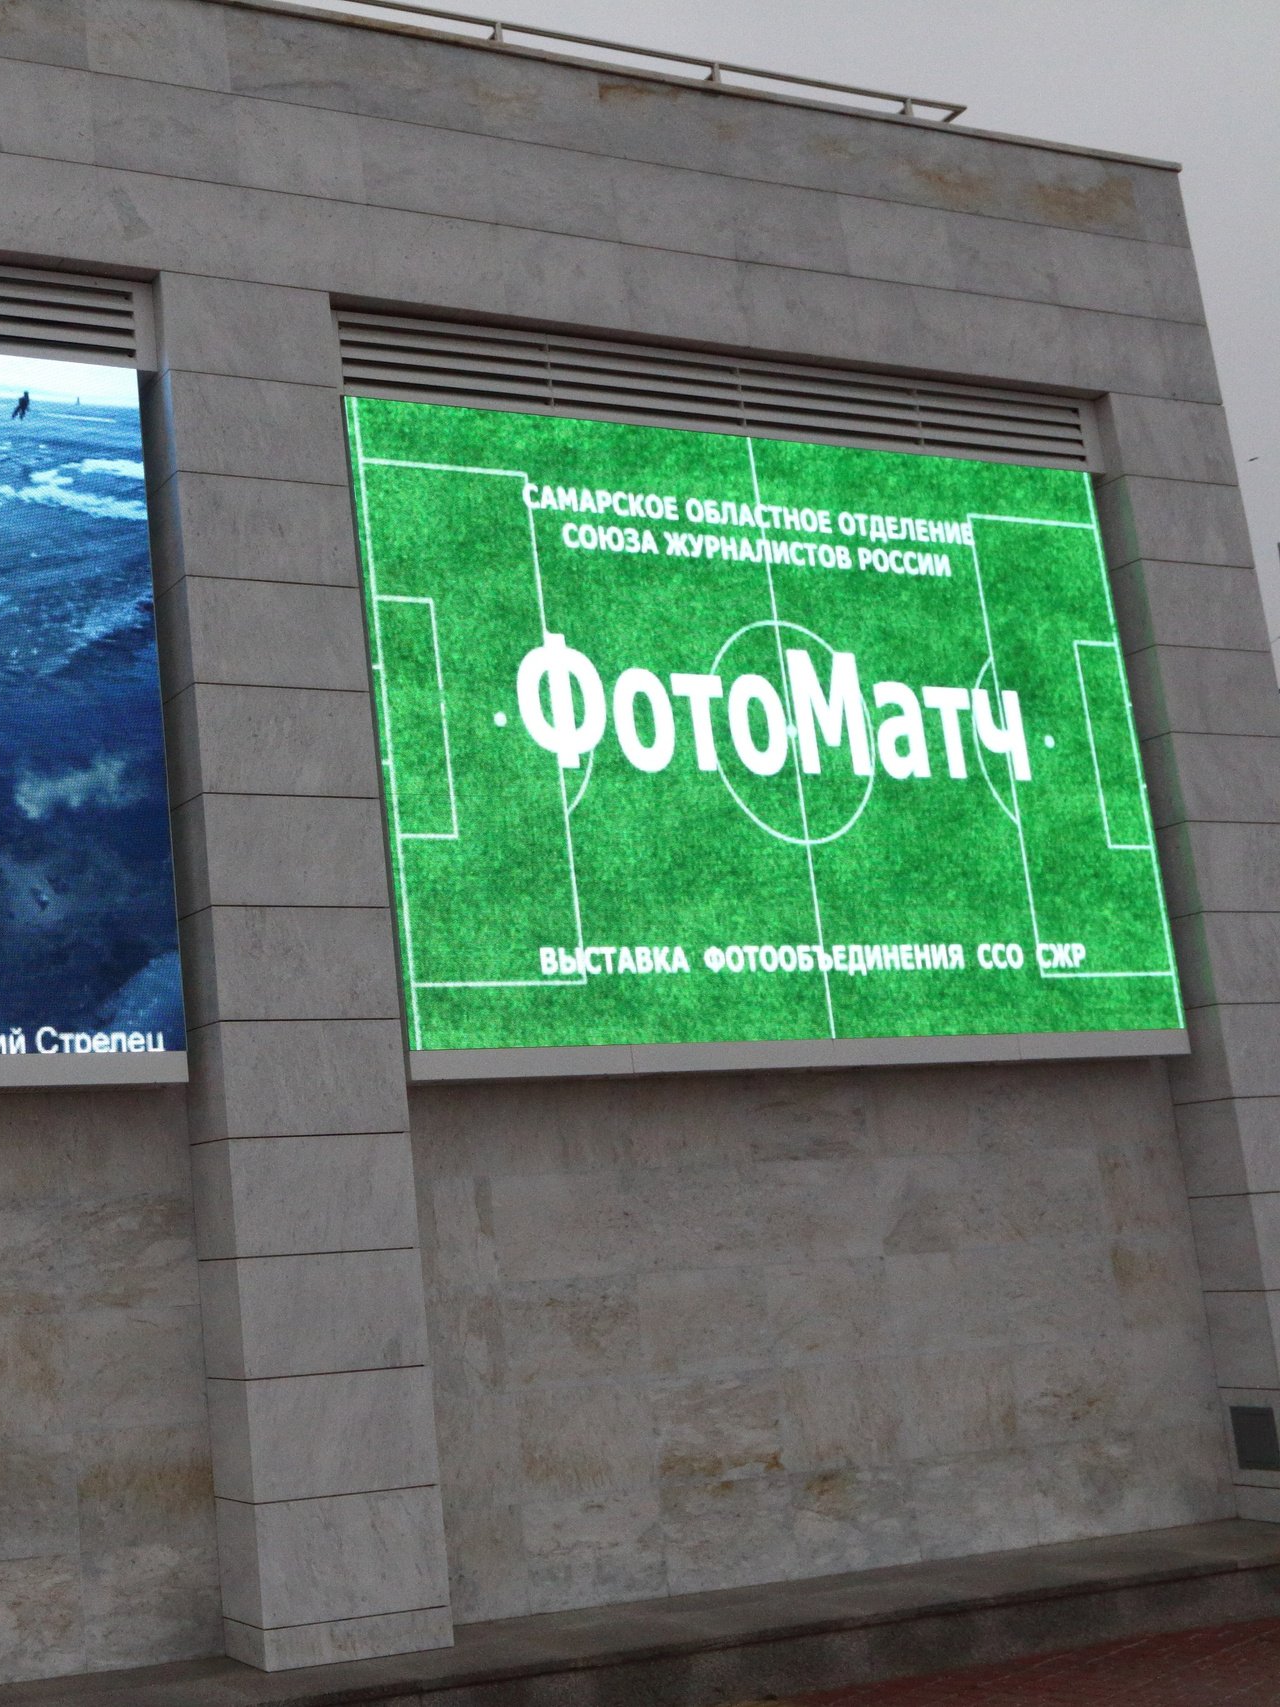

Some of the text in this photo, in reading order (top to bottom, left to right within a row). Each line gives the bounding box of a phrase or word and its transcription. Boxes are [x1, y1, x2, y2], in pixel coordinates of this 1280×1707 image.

[522, 483, 975, 546] САМАРСКОЕ ОБЛАСТНОЕ ОТДЕЛЕНИЕ
[562, 523, 952, 578] СОЮЗА ЖУРНАЛИСТОВ РОССИИ
[516, 633, 1032, 781] ФотоМатч
[540, 942, 1087, 976] ВЫСТАВКА ФОТООБЪЕДИНЕНИЯ ССО СЖР
